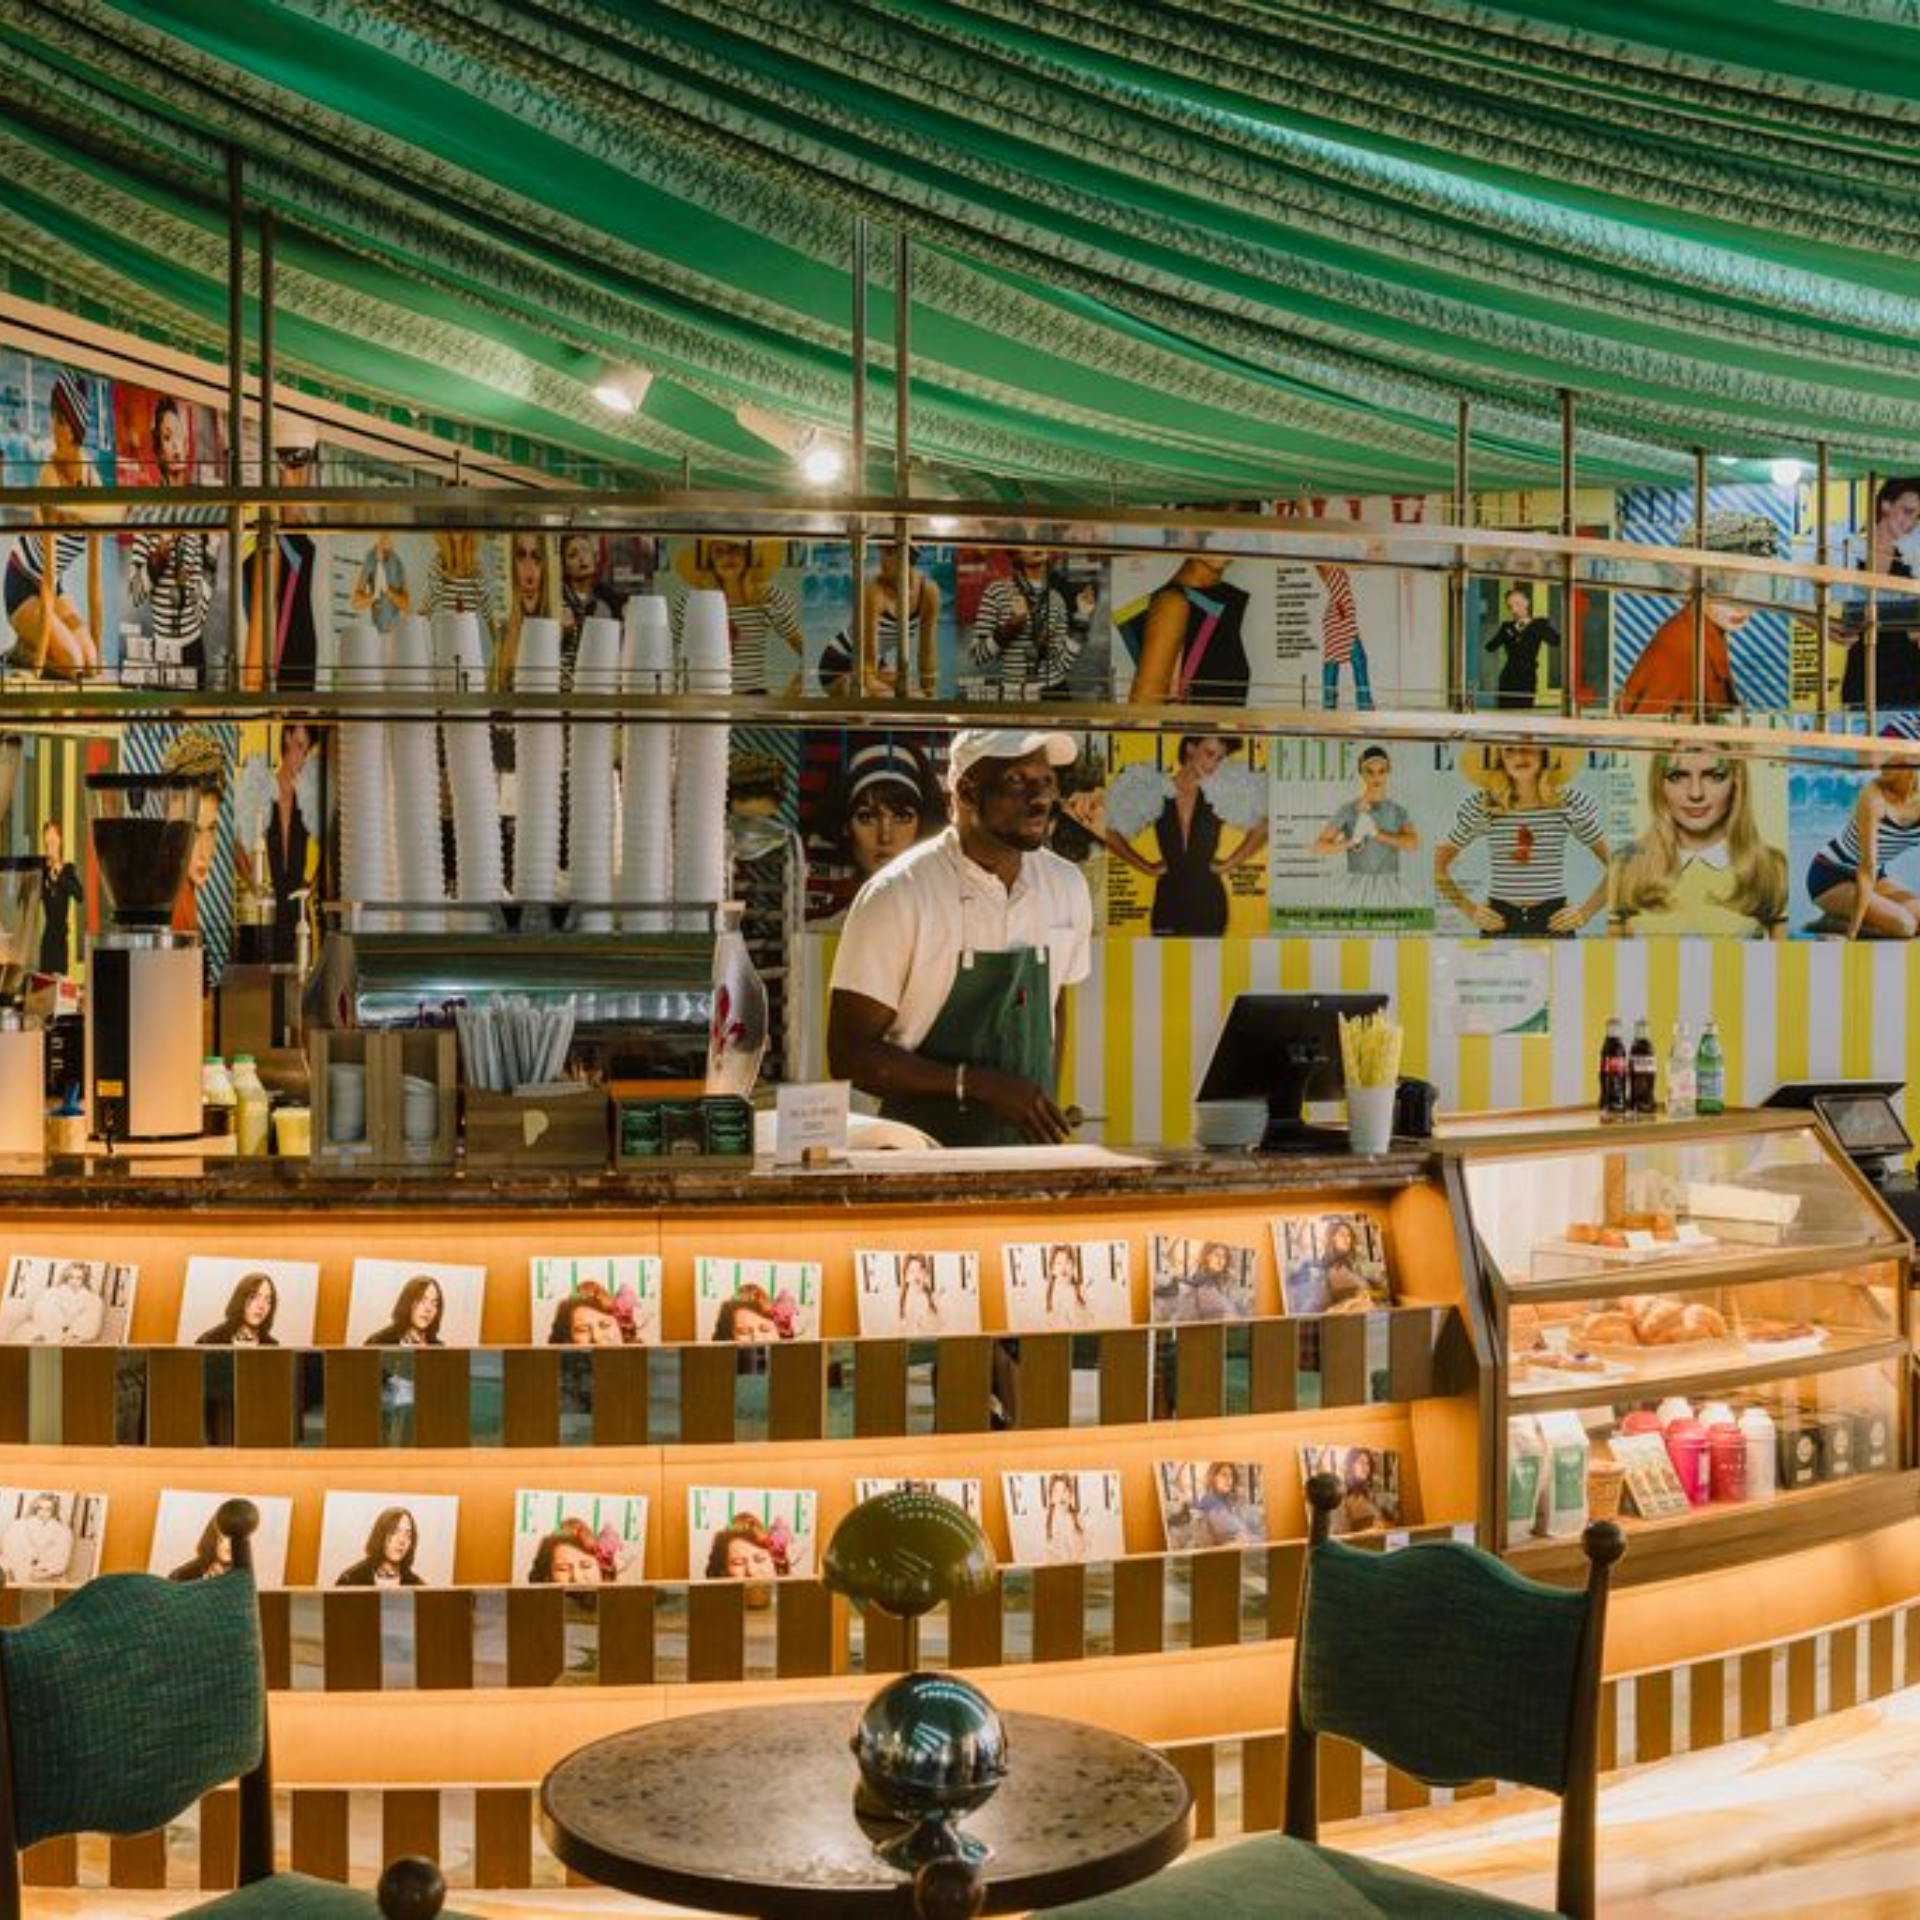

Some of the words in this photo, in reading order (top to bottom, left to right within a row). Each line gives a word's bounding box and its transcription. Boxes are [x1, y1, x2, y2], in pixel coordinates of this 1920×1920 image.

[1277, 736, 1358, 782] ELLE
[537, 1258, 656, 1301] ELLE
[703, 1258, 816, 1306] ELLE
[862, 1252, 977, 1294] ELLE
[1009, 1241, 1127, 1288] ELLE
[521, 1491, 641, 1542] ELLE
[694, 1488, 811, 1534] ELLE
[1009, 1473, 1122, 1516] ELLE
